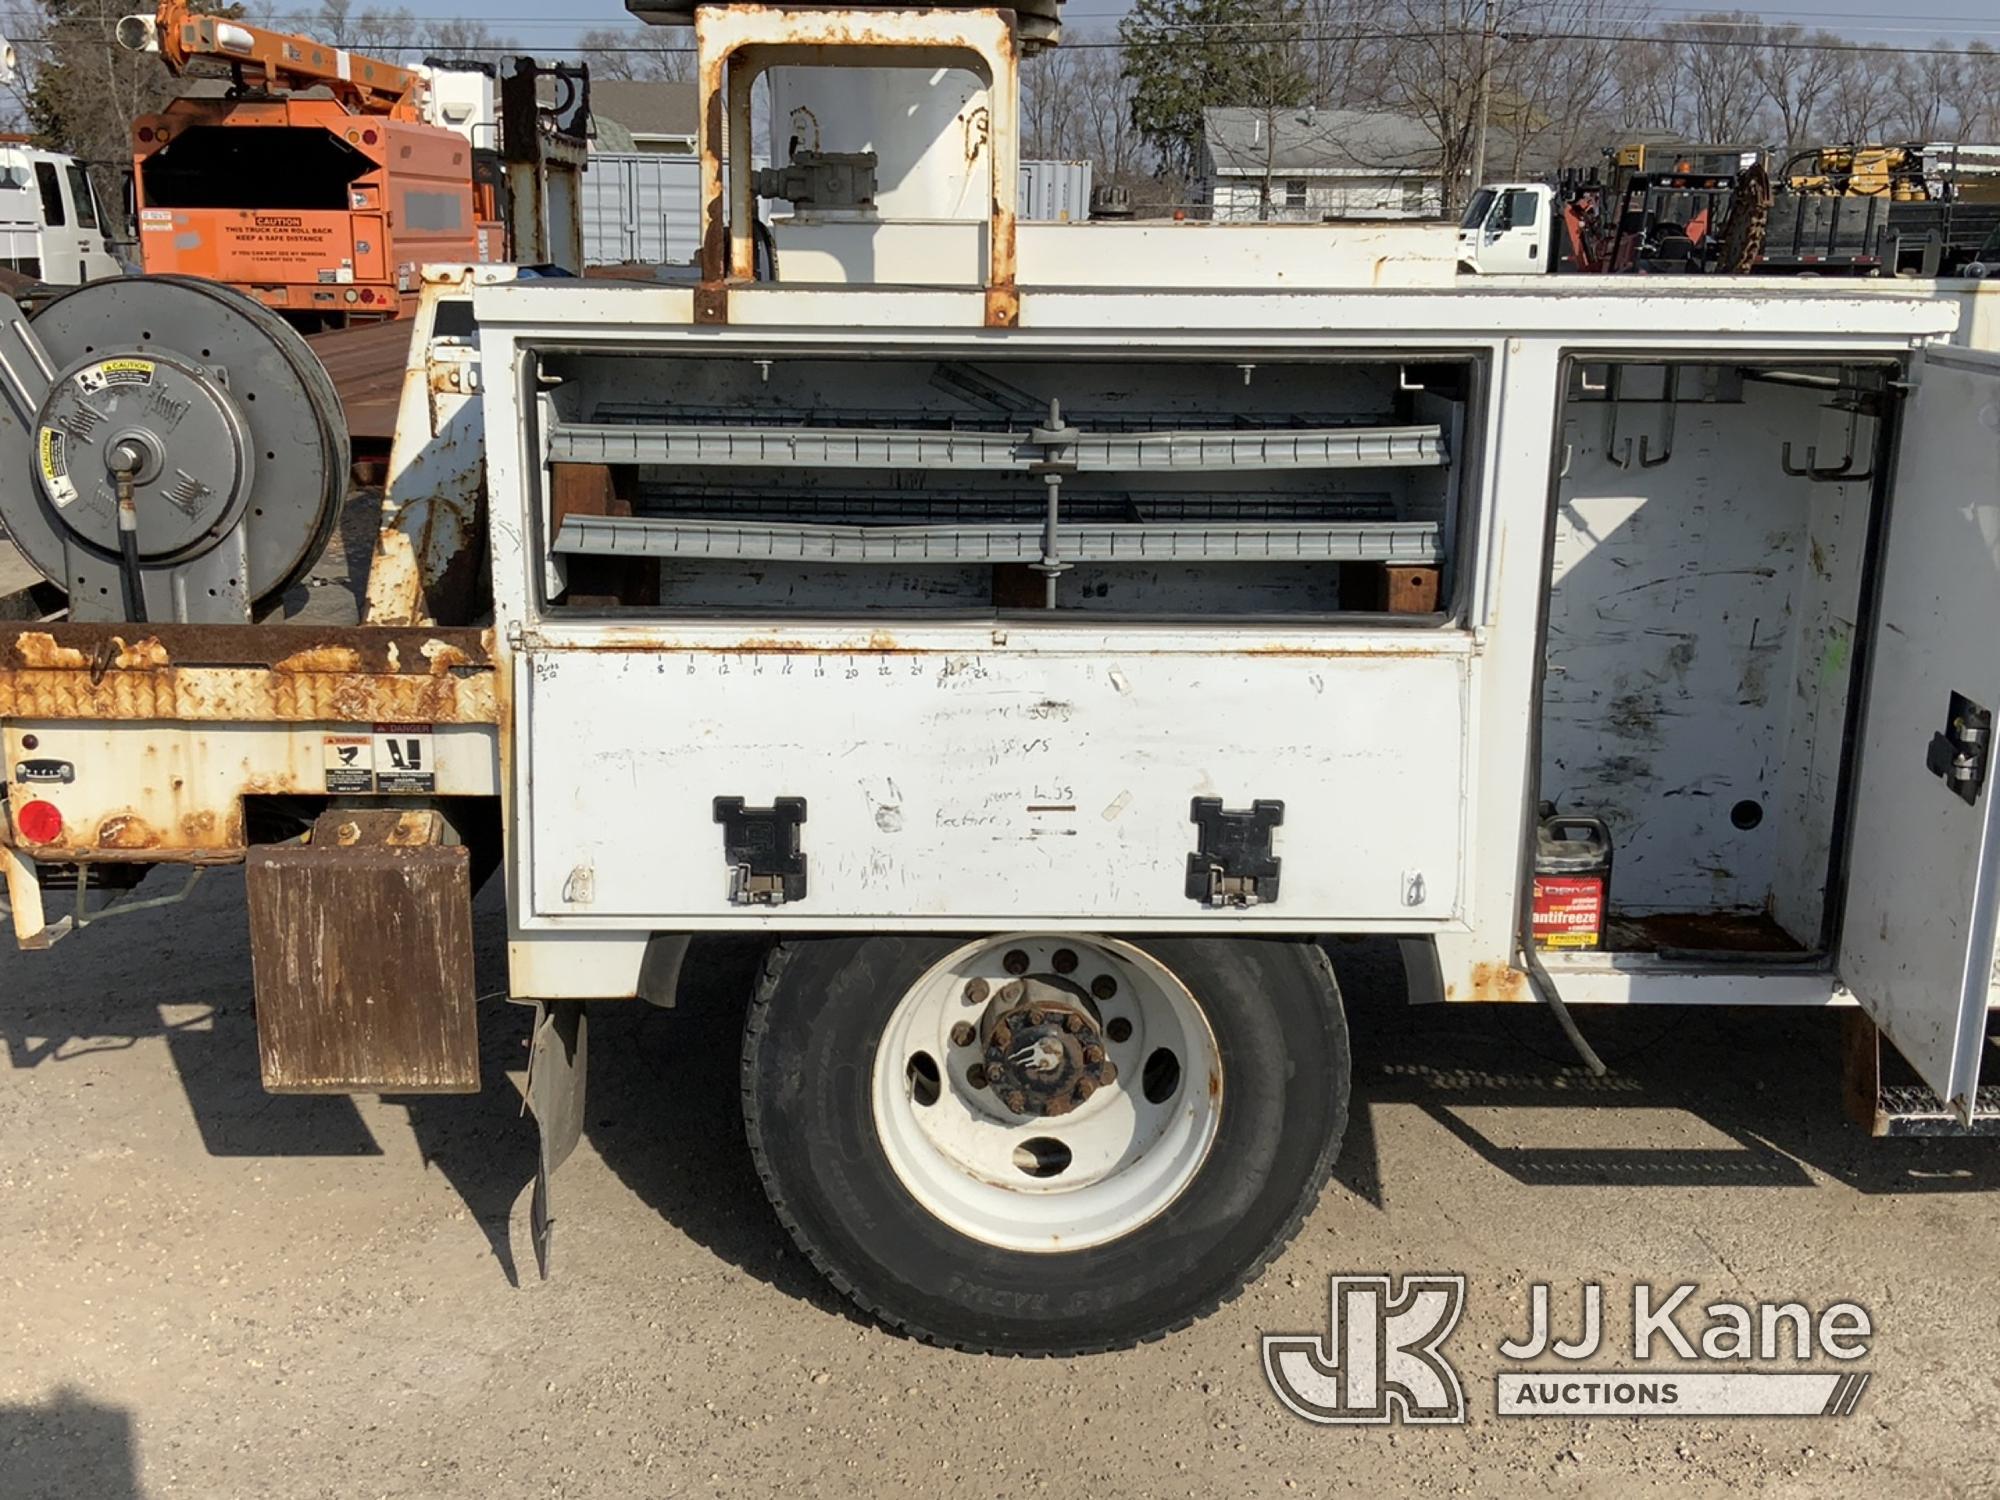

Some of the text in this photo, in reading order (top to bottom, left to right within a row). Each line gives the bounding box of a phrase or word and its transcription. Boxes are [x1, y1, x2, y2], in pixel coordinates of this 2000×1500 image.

[257, 217, 301, 226] CAUTION
[113, 361, 149, 370] CAUTION
[42, 432, 52, 470] CAUTION
[686, 666, 695, 675] 10
[718, 664, 730, 675] 12
[845, 669, 859, 679] 20
[878, 666, 891, 676] 22
[911, 665, 923, 676] 24
[390, 725, 430, 733] DANGER
[1533, 911, 1596, 924] antifreeze
